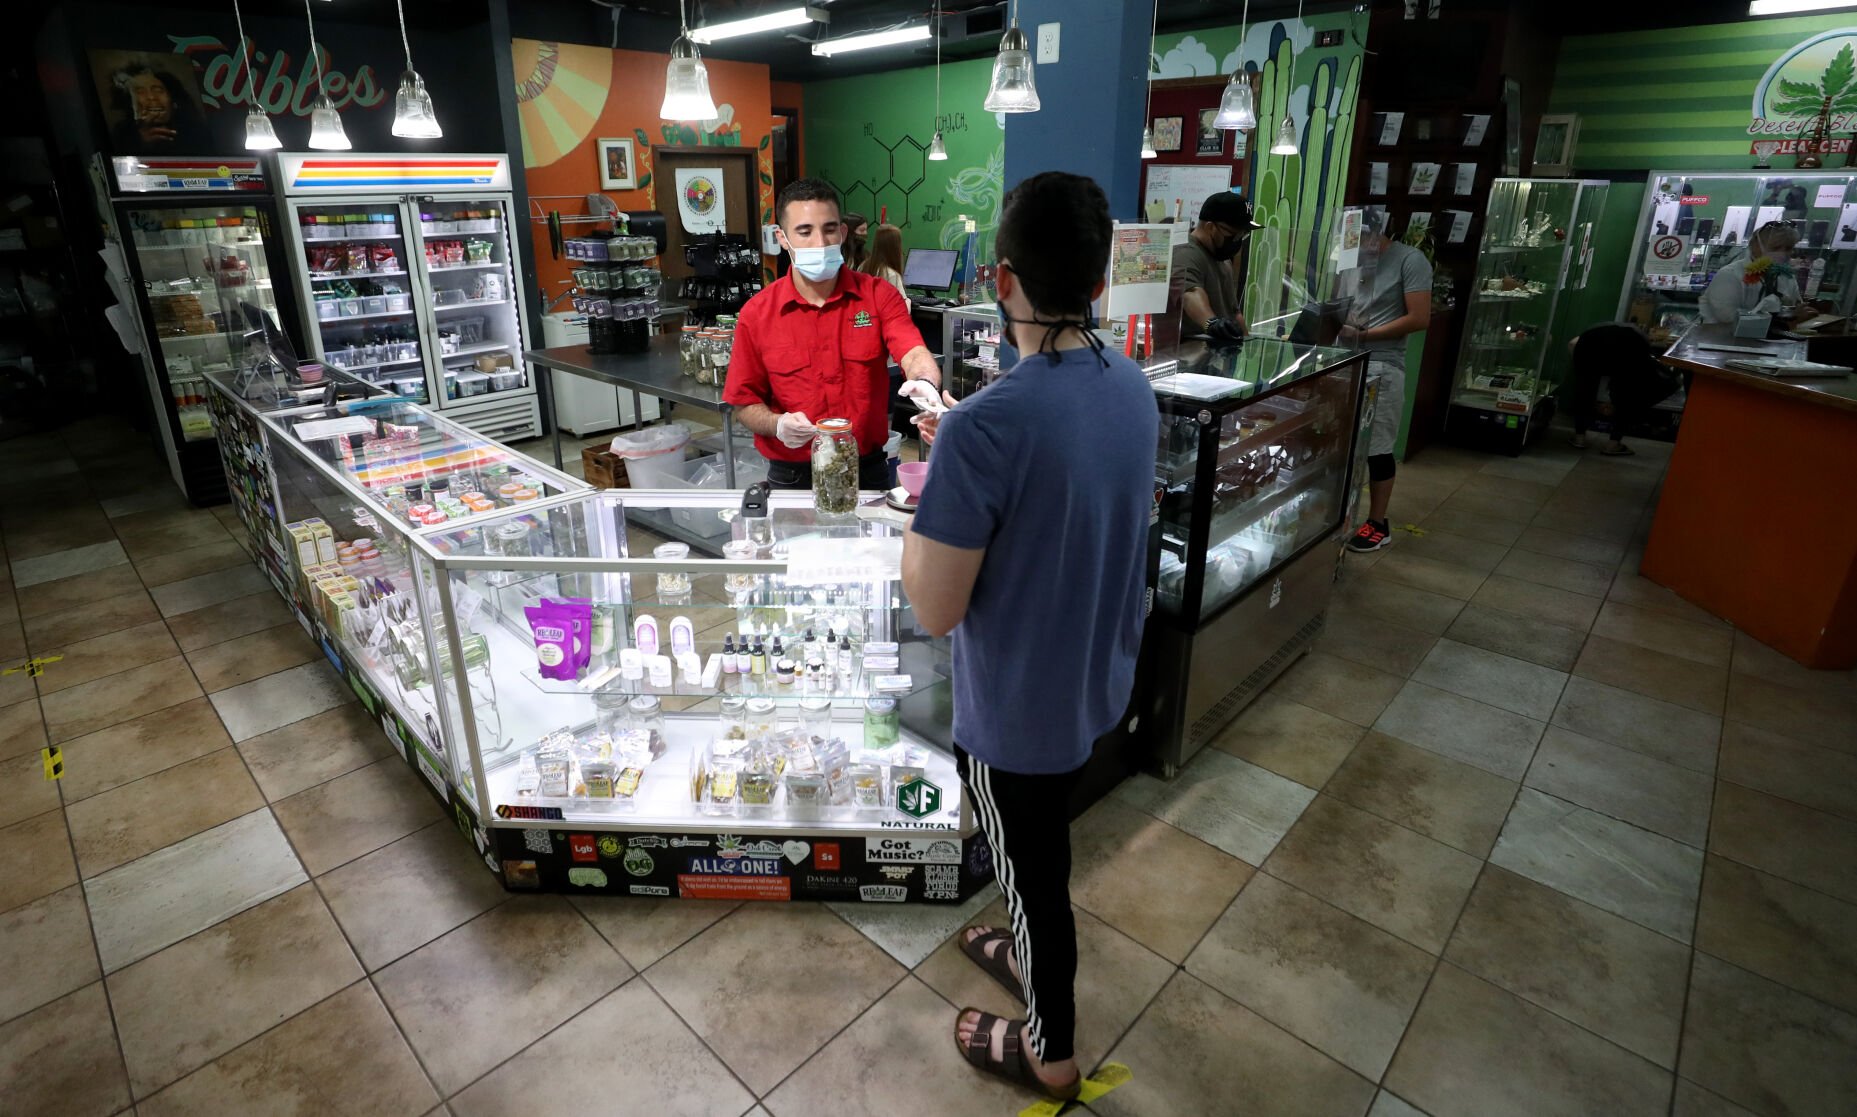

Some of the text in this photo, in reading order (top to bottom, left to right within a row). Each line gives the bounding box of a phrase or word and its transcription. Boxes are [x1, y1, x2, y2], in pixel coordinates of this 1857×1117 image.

[167, 35, 387, 117] Edibles
[1750, 117, 1820, 133] Desert
[1780, 140, 1812, 153] LEA
[920, 783, 935, 814] F
[881, 821, 957, 831] NATURAL
[575, 845, 592, 855] Lgb
[881, 840, 911, 850] Got
[821, 853, 833, 861] Ss
[868, 849, 924, 860] Music?
[691, 859, 778, 874] ALL ONE!
[843, 875, 858, 884] 420
